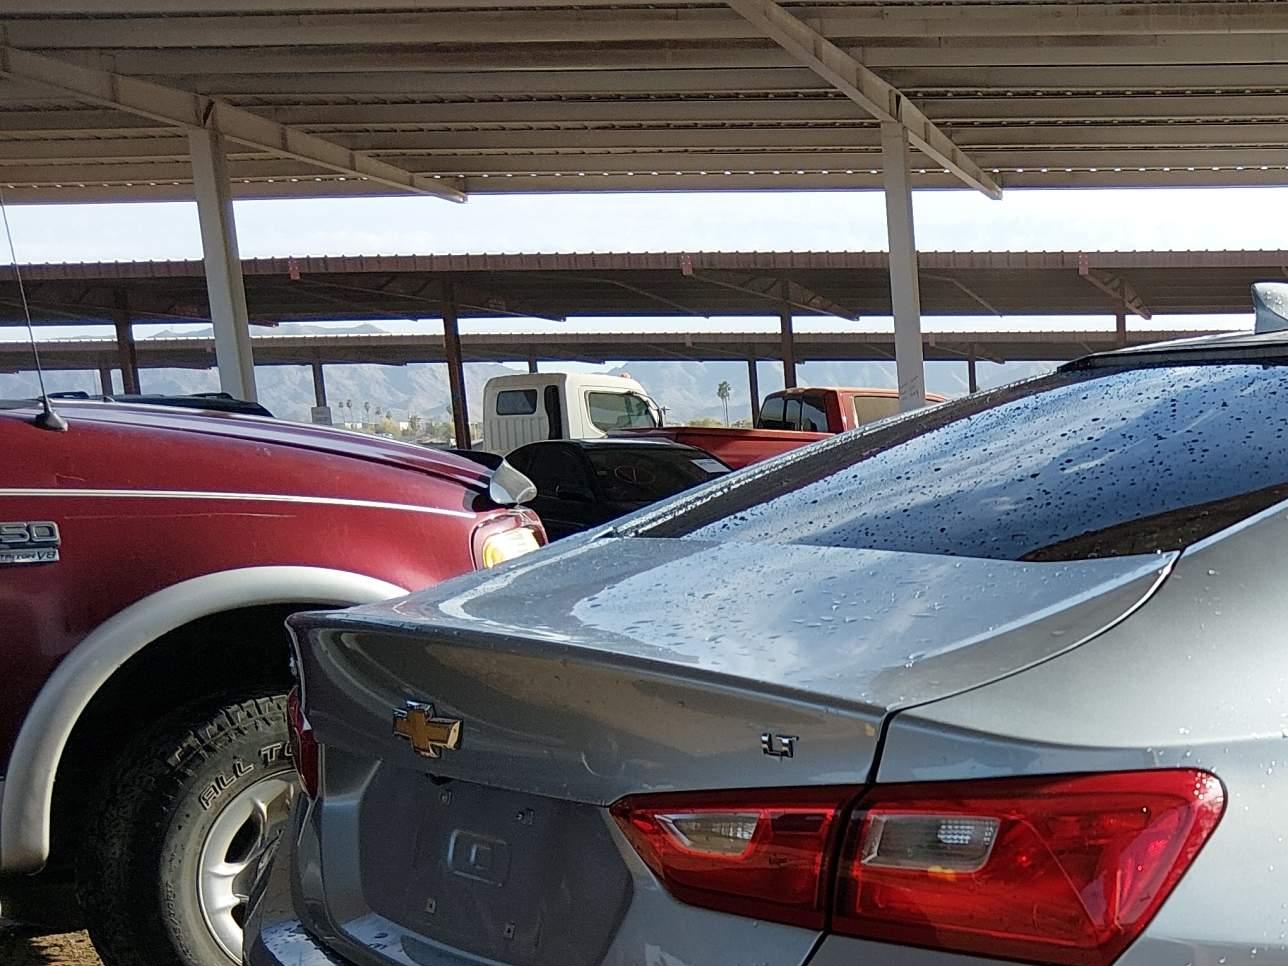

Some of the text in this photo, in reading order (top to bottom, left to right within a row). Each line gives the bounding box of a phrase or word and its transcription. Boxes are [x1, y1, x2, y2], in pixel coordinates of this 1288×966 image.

[36, 550, 56, 560] V8
[760, 732, 800, 758] LT
[198, 759, 255, 809] ALL
